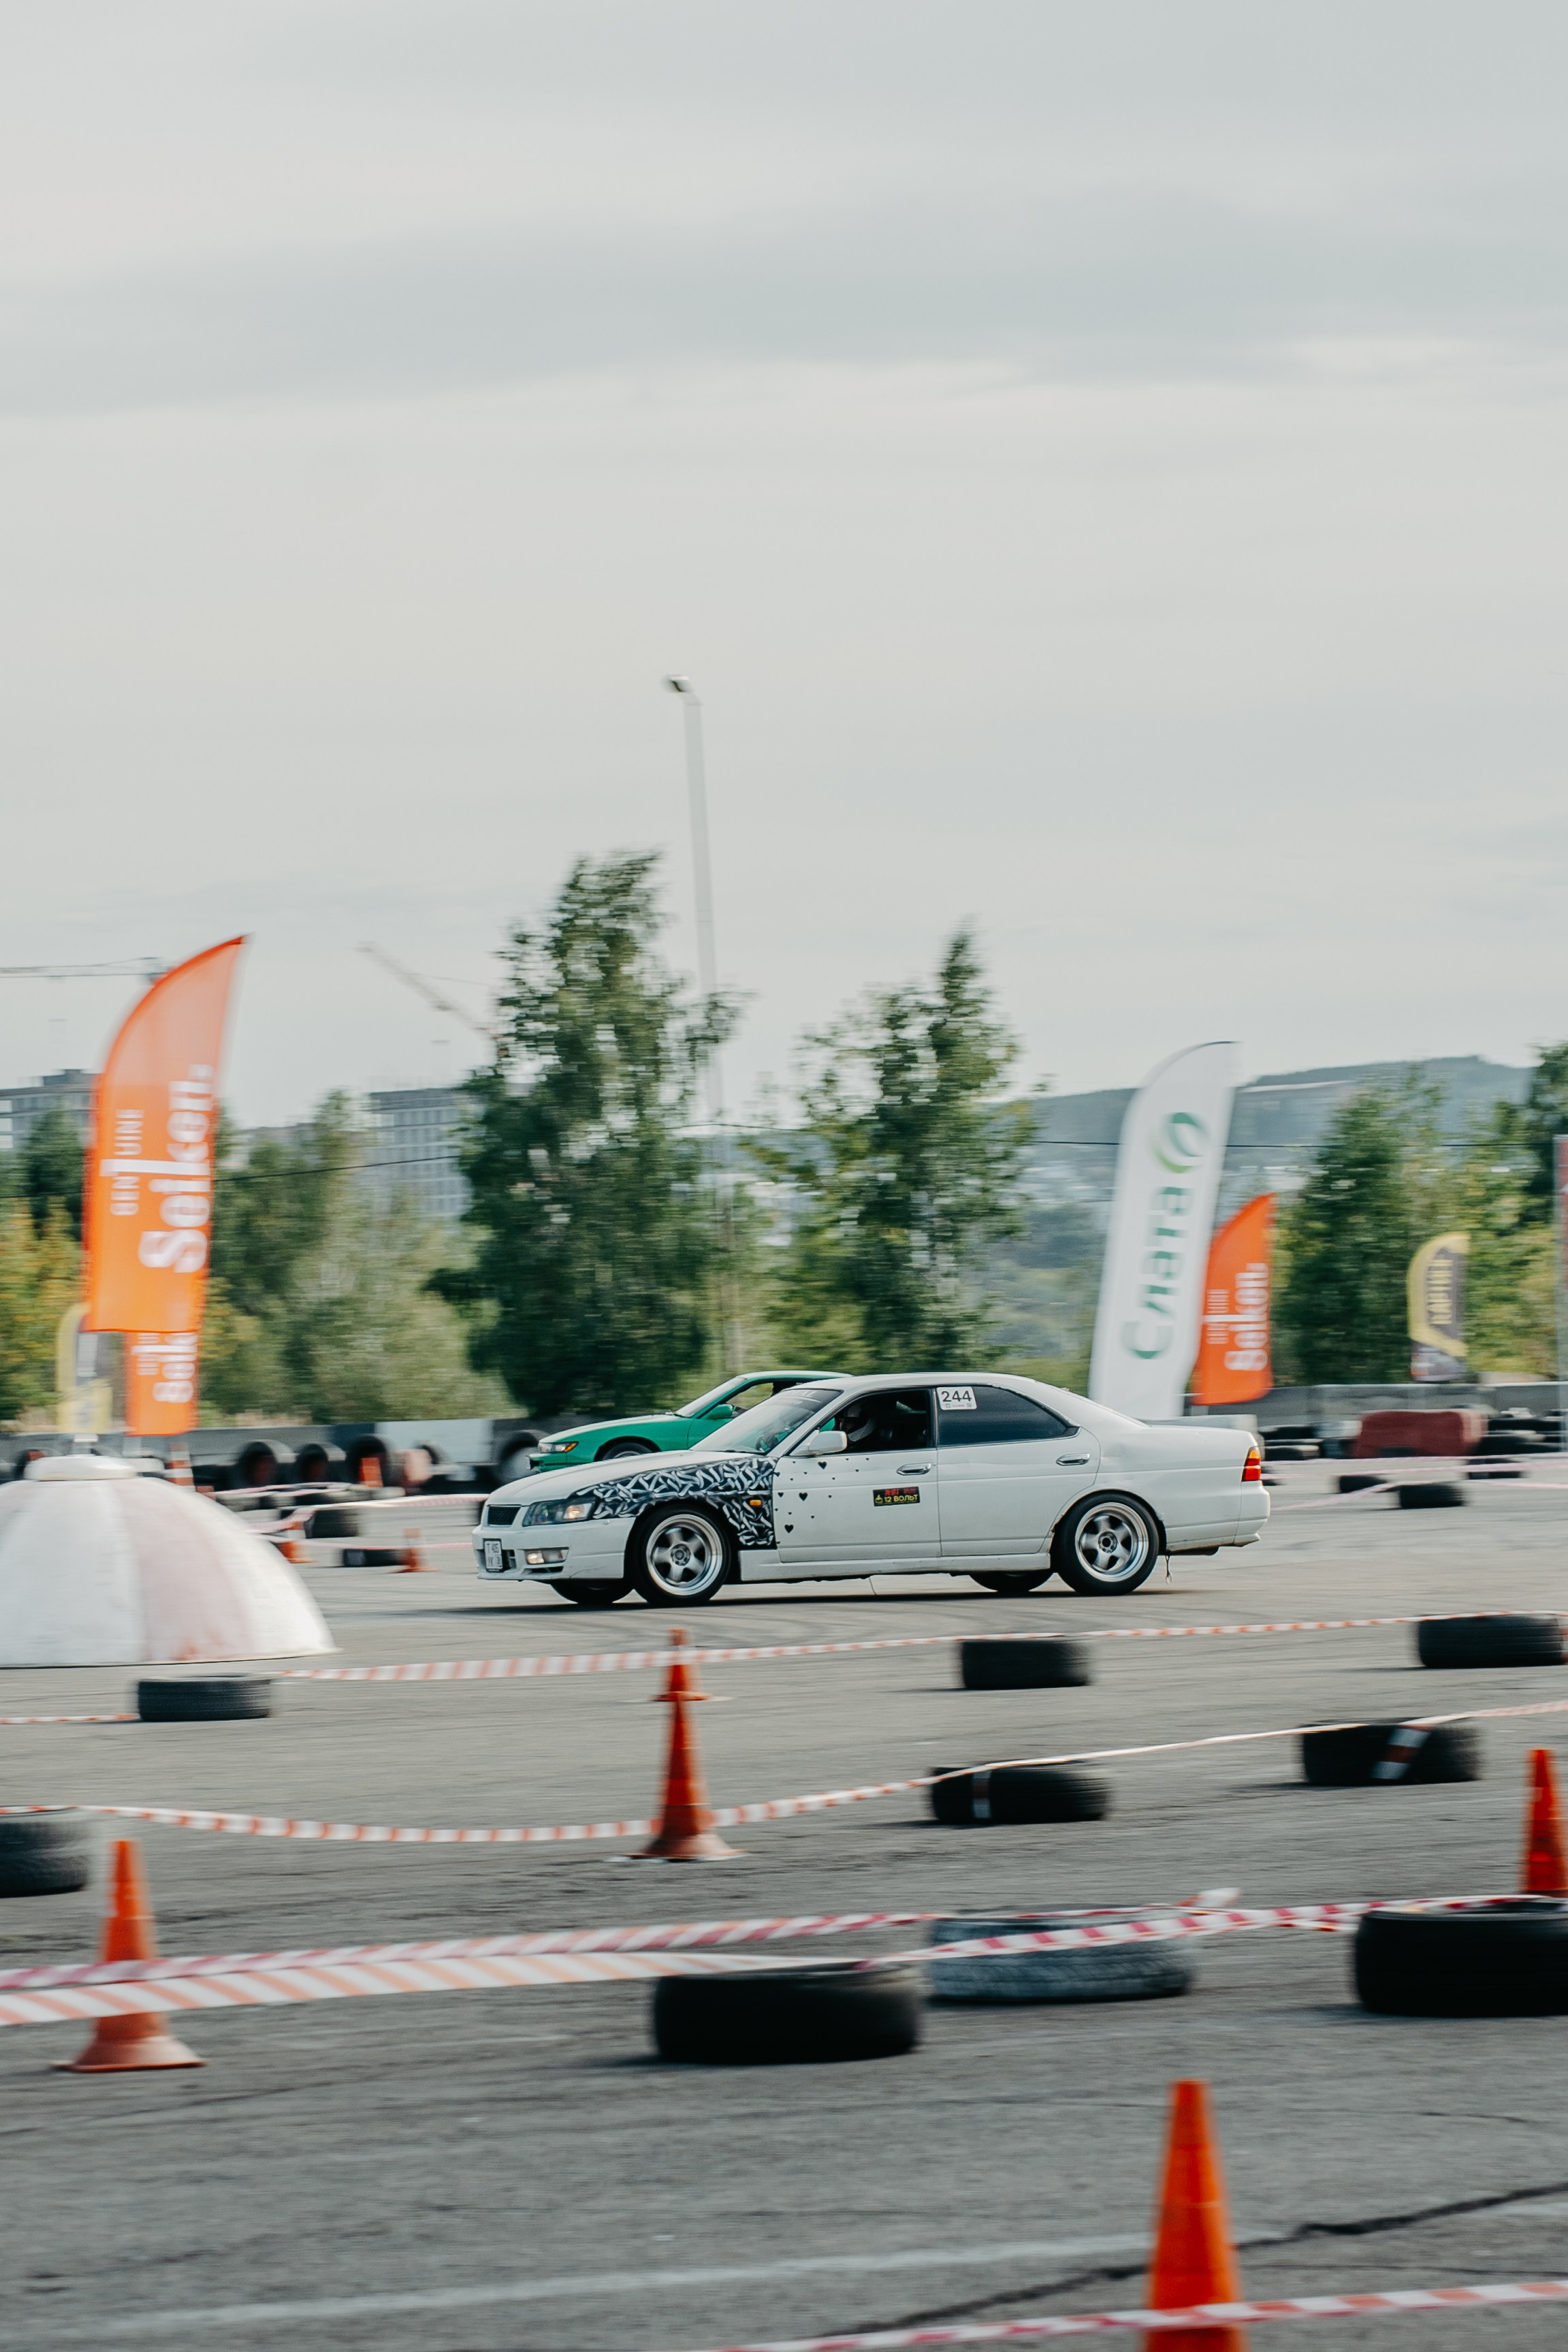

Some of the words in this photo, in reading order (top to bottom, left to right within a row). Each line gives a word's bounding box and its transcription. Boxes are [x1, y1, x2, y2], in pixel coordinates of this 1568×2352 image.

[1121, 1186, 1196, 1359] Слата
[941, 1390, 972, 1402] 244
[893, 1494, 918, 1502] ВОЛЬТ
